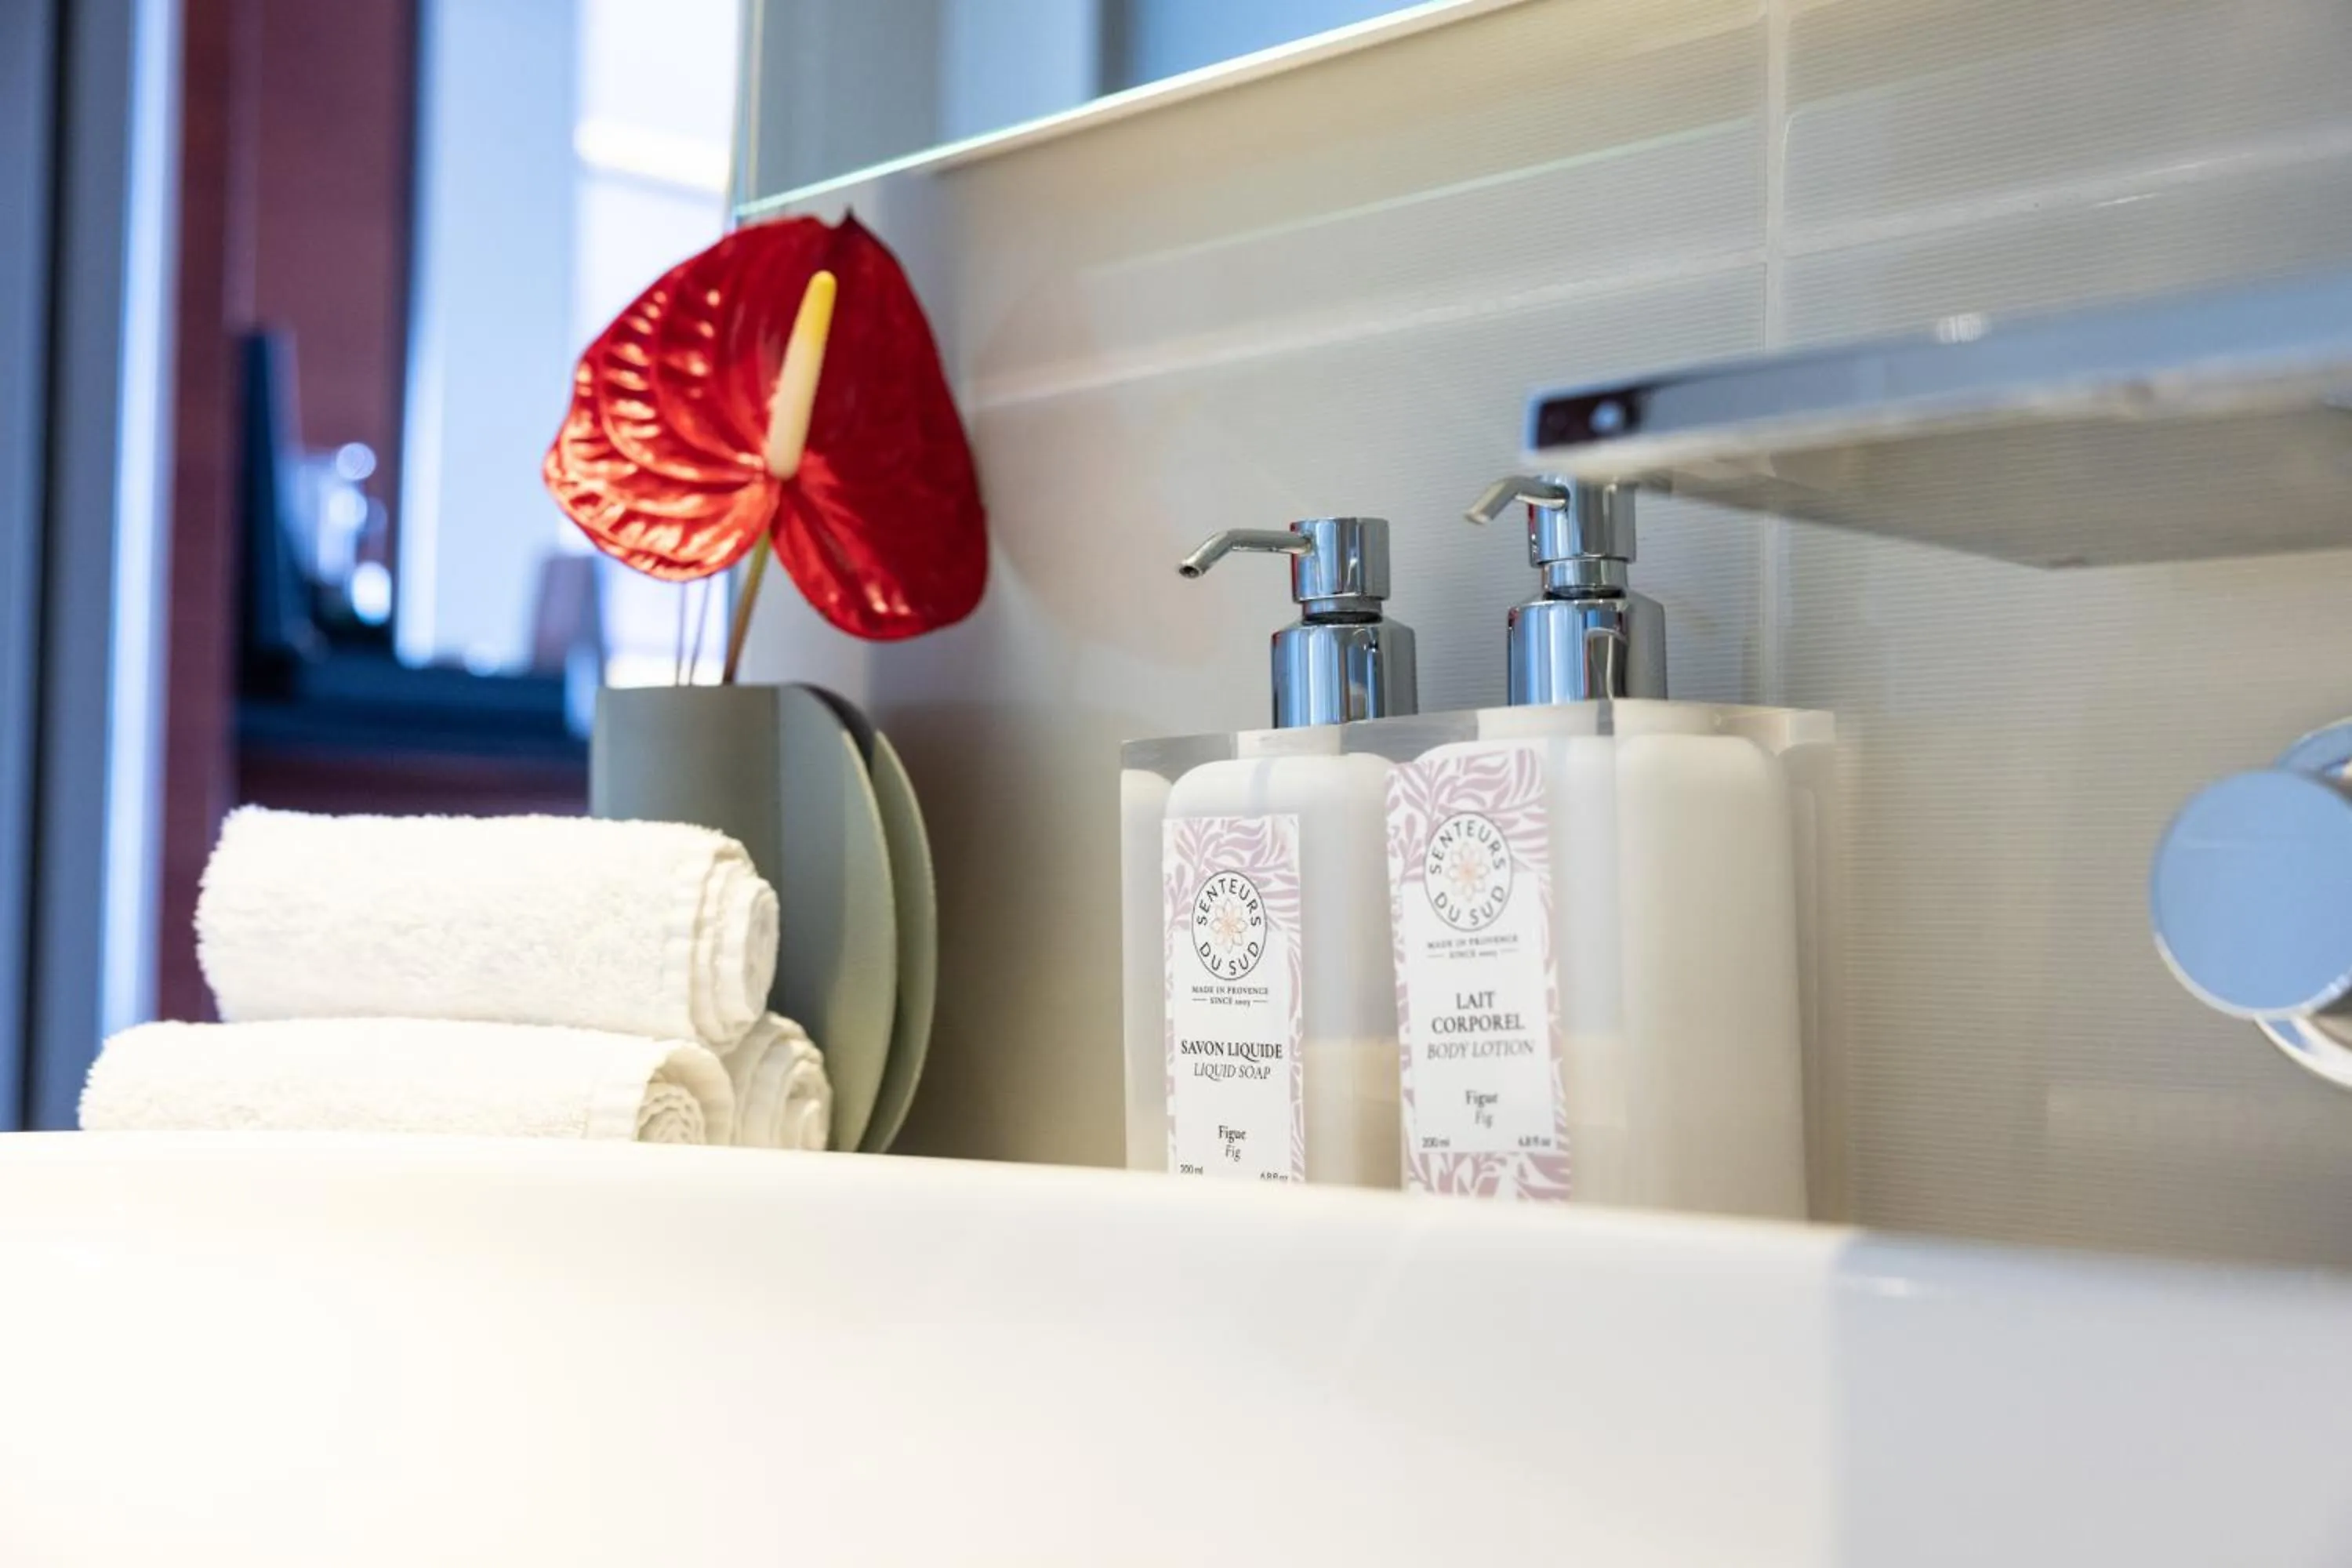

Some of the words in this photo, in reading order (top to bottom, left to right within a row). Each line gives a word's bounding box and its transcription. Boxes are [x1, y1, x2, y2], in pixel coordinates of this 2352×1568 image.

[1429, 820, 1506, 875] SENTEURS
[1196, 878, 1261, 926] SENTEURS
[1434, 891, 1461, 923] DU
[1469, 886, 1504, 926] SUD
[1199, 942, 1221, 971] DU
[1229, 942, 1259, 975] SUD
[1227, 986, 1268, 995] PROVENCE
[1456, 991, 1495, 1010] LAIT
[1432, 1014, 1526, 1034] CORPOREL
[1181, 1040, 1224, 1056] SAVON
[1228, 1043, 1283, 1062] LIQUIDE
[1427, 1041, 1468, 1060] BODY
[1472, 1040, 1535, 1058] LOTION
[1193, 1062, 1236, 1082] LIQUID
[1239, 1065, 1271, 1080] SOAP
[1475, 1109, 1493, 1129] Fig
[1218, 1124, 1247, 1143] Figue
[1225, 1144, 1241, 1162] Fig
[1180, 1164, 1194, 1174] 200
[1195, 1166, 1203, 1175] ml
